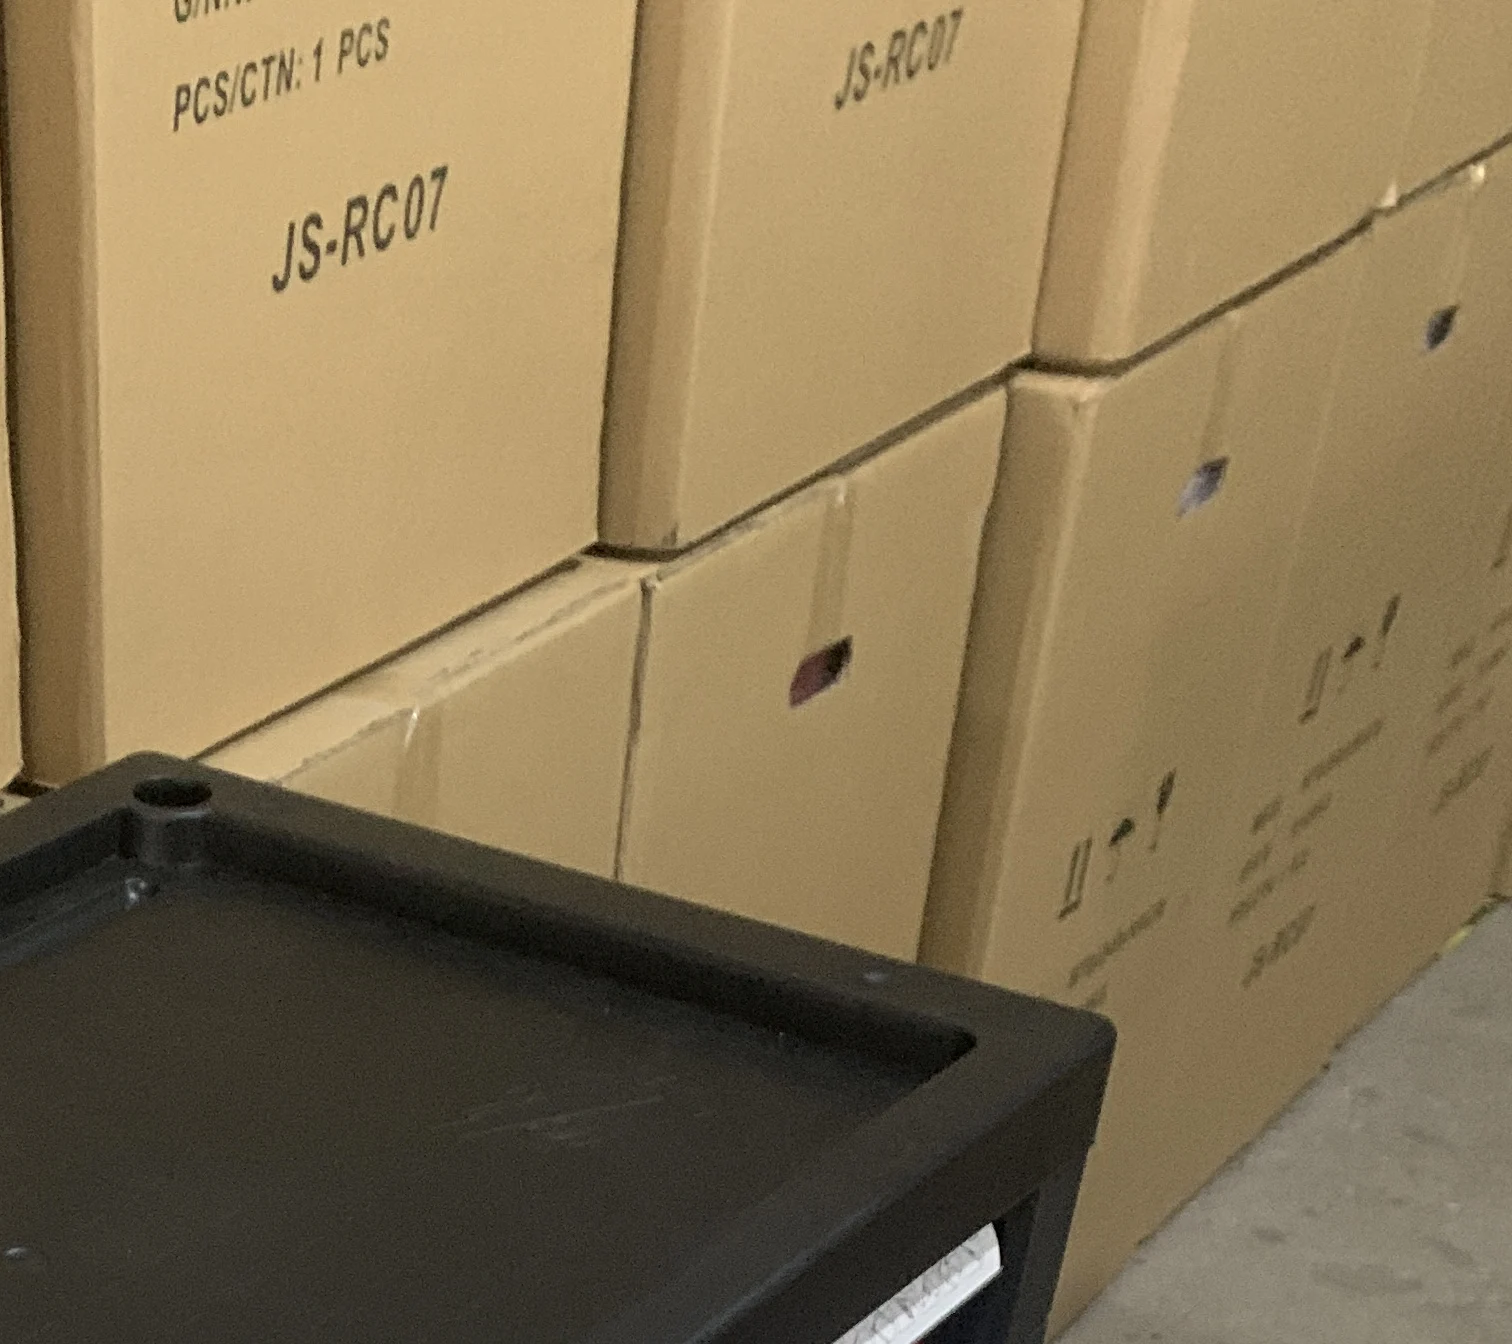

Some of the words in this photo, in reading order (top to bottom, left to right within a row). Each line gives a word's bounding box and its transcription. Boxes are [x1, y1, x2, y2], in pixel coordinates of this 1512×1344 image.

[173, 48, 303, 132] PCS/CTN:
[313, 37, 324, 82] 1
[337, 17, 391, 74] PCS
[271, 165, 449, 293] JS-RC07
